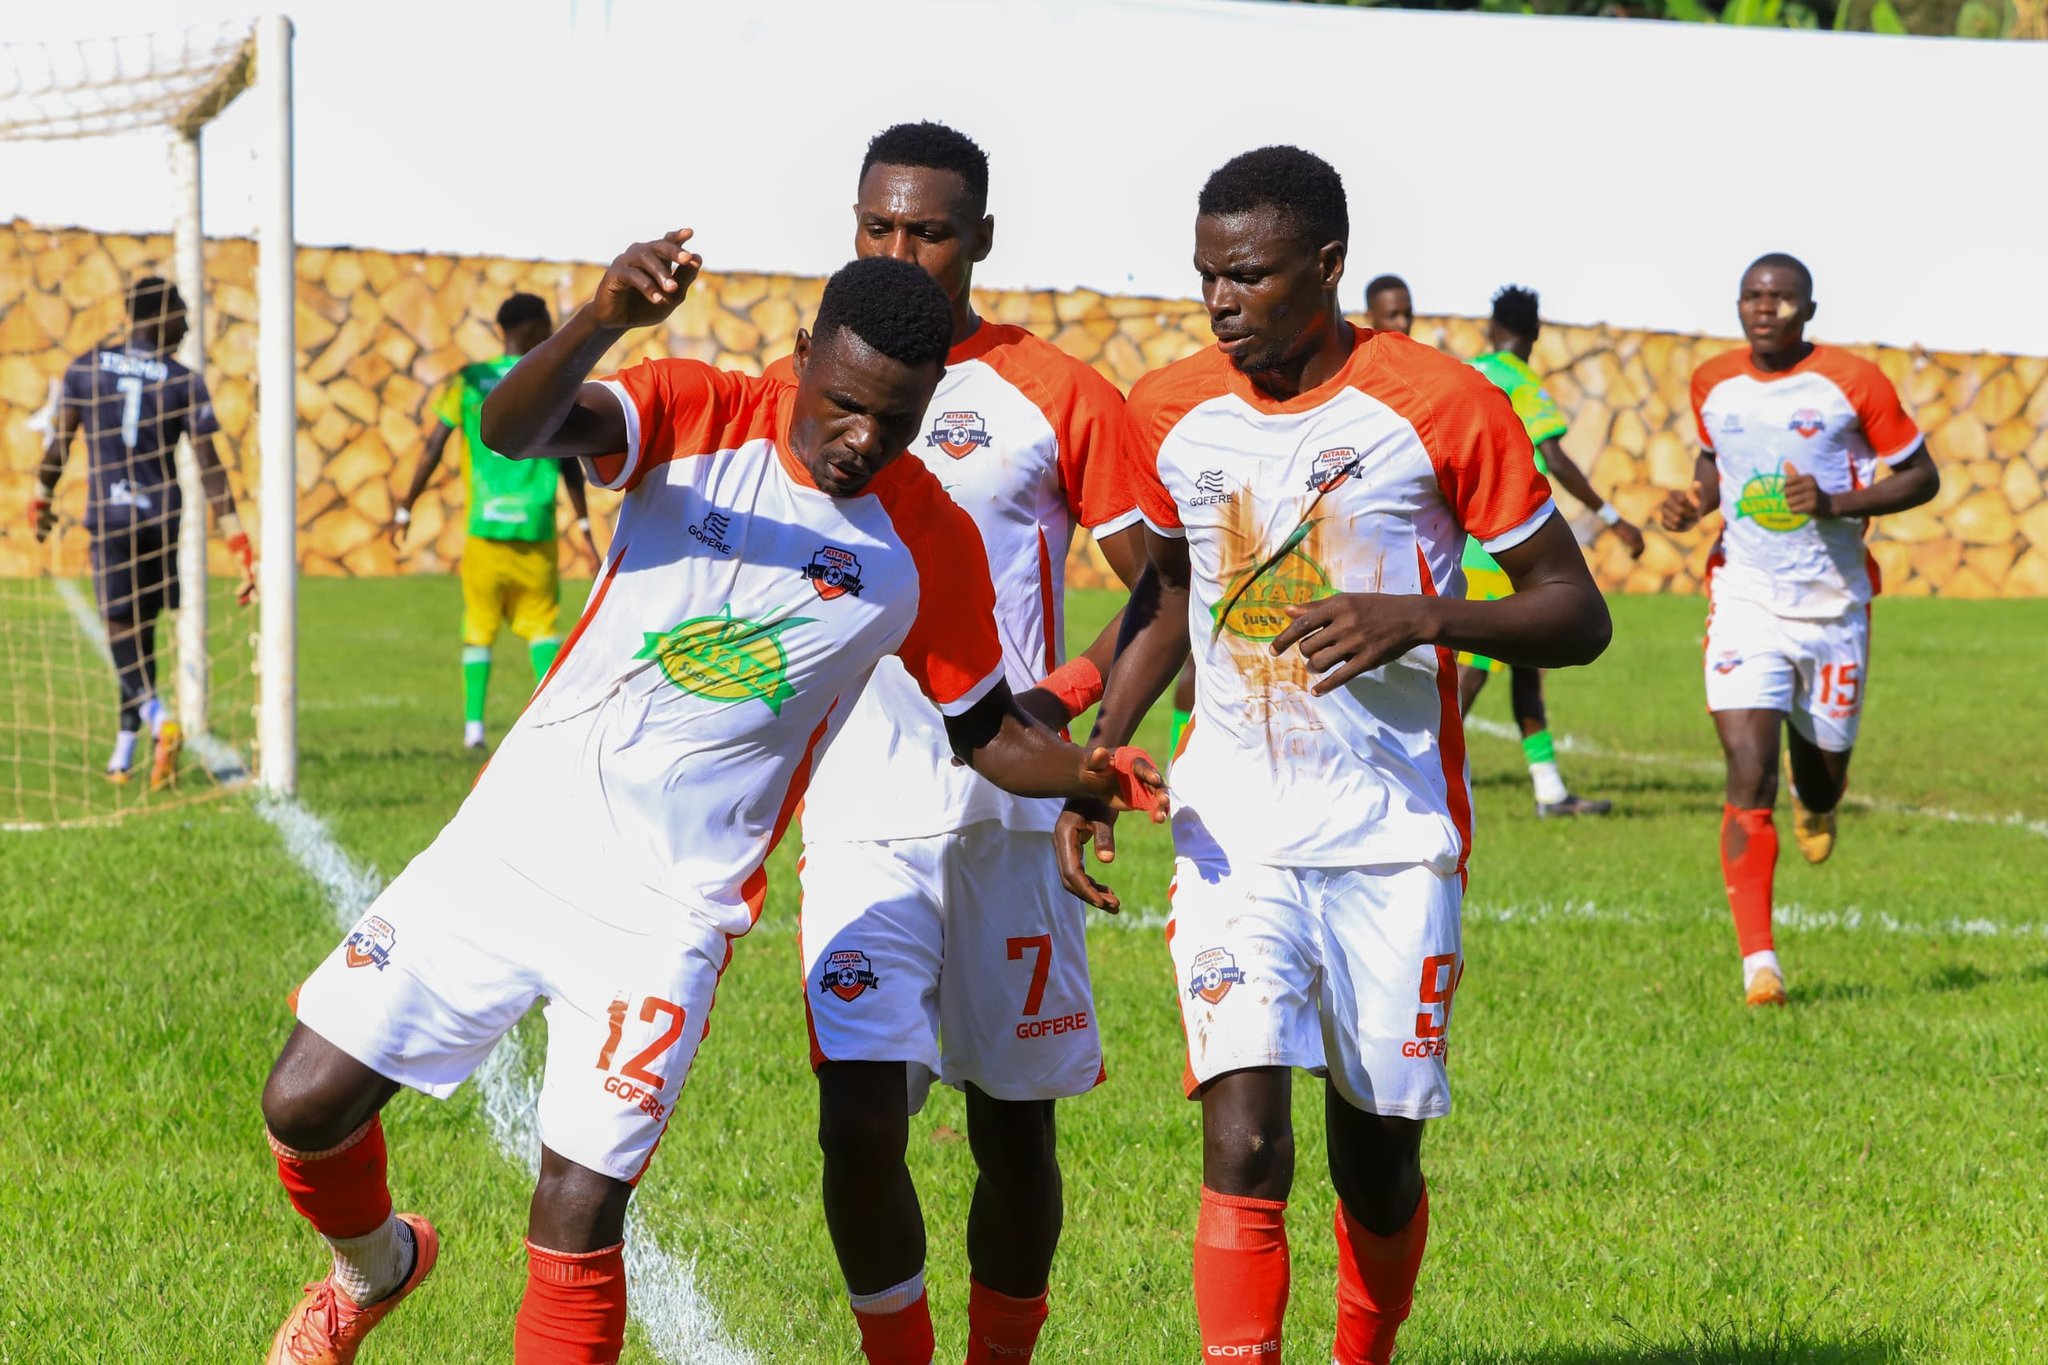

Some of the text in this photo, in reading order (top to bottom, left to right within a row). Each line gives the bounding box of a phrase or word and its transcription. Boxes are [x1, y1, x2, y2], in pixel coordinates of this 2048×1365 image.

[1322, 450, 1351, 459] KITARA
[1190, 494, 1233, 507] GOFERE
[688, 524, 732, 555] GOFERE
[826, 549, 853, 562] KITARA
[1242, 612, 1285, 626] Sugar
[1820, 662, 1858, 706] 15
[1198, 951, 1221, 962] KITARA
[1006, 932, 1053, 1016] 7
[1415, 952, 1456, 1039] 9
[1016, 1011, 1089, 1040] GOFERE
[595, 990, 687, 1091] 12
[603, 1076, 665, 1124] GOFERE
[1207, 1340, 1278, 1357] GOFERE
